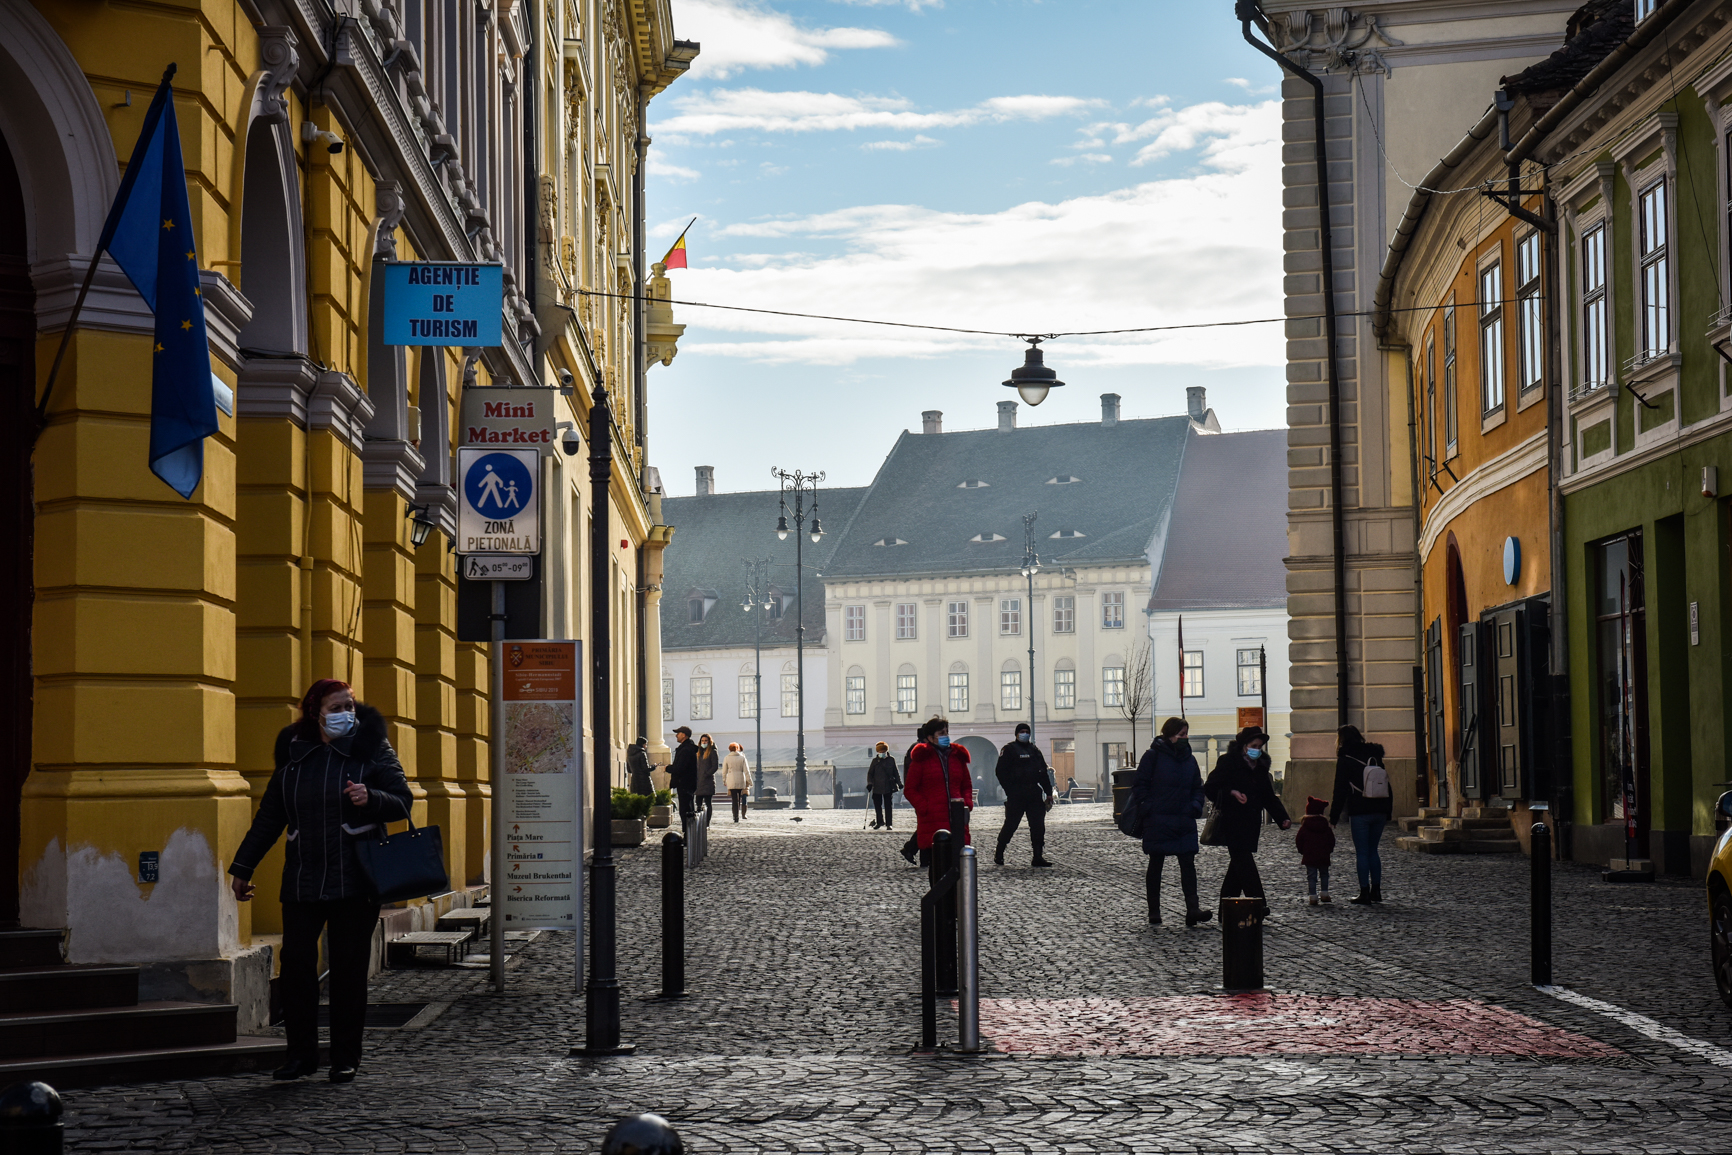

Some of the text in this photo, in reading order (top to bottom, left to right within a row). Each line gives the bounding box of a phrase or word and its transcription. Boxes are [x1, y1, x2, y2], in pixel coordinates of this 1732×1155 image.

[408, 267, 480, 290] AGENȚIE
[433, 295, 454, 312] DE
[409, 319, 478, 337] TURISM
[484, 402, 534, 417] Mini
[468, 427, 550, 443] Market
[484, 519, 515, 534] ZONĂ
[468, 535, 531, 550] PIETONALĂ
